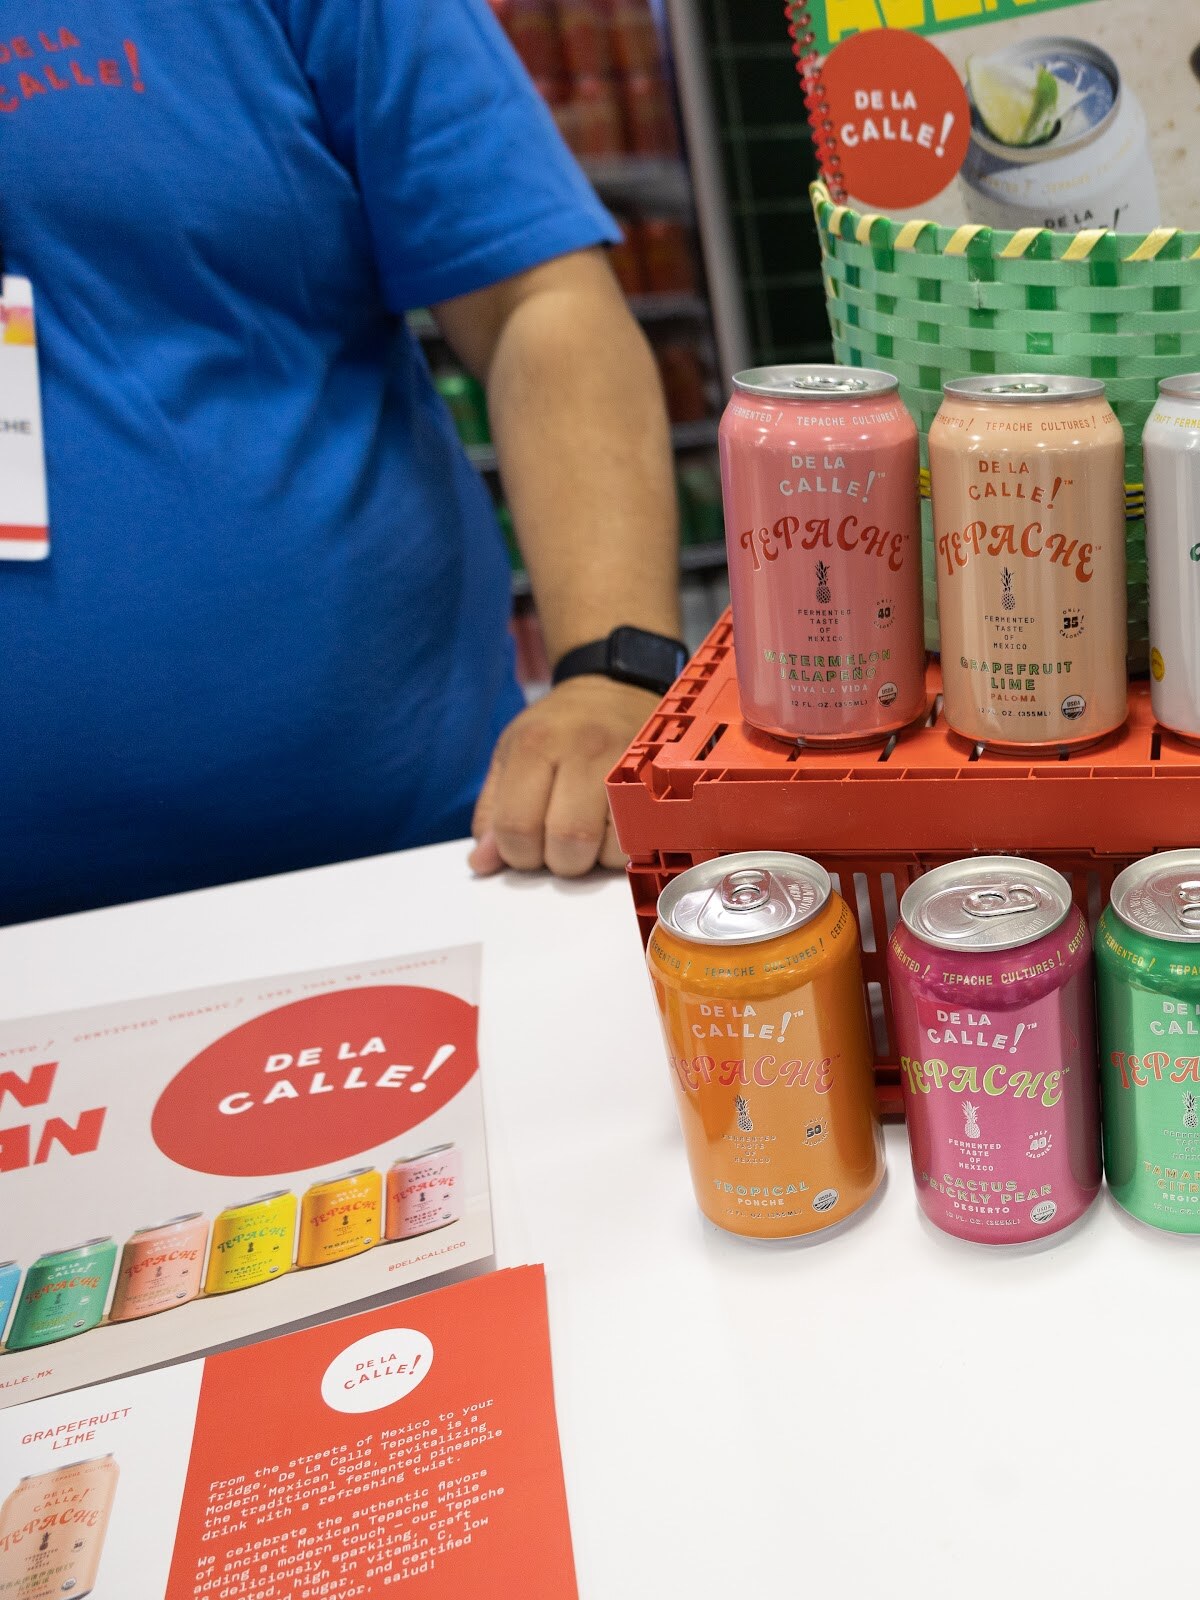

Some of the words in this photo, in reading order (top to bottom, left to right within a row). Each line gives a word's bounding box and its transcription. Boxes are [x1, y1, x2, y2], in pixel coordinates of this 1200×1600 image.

[37, 26, 81, 53] LA
[854, 90, 884, 111] DE
[890, 91, 917, 111] LA
[840, 112, 956, 157] CALLE!
[797, 415, 845, 427] TEPACHE
[851, 407, 901, 425] CULTURES!
[986, 421, 1033, 432] TEPACHE
[1041, 416, 1097, 432] CULTURES!
[791, 455, 816, 470] DE
[823, 456, 846, 470] LA
[979, 460, 1000, 473] DE
[1008, 461, 1030, 474] LA
[779, 470, 876, 504] CALLE!
[968, 476, 1062, 509] CALLE!
[739, 515, 905, 573] TEPACHE
[938, 520, 1094, 583] TEPACHE
[797, 608, 852, 616] FERMENTED
[877, 606, 892, 619] 40
[984, 615, 1035, 624] FERMENTED
[993, 642, 1027, 650] MEXICO
[764, 649, 892, 668] WATERMELON
[960, 656, 1073, 676] GRAPEFRUIT
[779, 667, 877, 682] JALAPEÑO
[990, 677, 1036, 691] LIME
[841, 684, 869, 694] VIDA
[990, 694, 1036, 702] PALOMA
[704, 966, 756, 977] TEPACHE
[942, 972, 993, 986] TEPACHE
[1001, 950, 1064, 984] CULTURES!
[700, 1004, 725, 1017] DE
[732, 1004, 757, 1018] LA
[936, 1010, 961, 1025] DE
[967, 1013, 991, 1026] LA
[1162, 1001, 1188, 1015] DE
[691, 1011, 792, 1043] CALLE!
[926, 1022, 1025, 1054] CALLE!
[263, 1046, 321, 1074] DE
[337, 1036, 388, 1061] LA
[217, 1043, 457, 1116] CALLE!
[900, 1055, 1063, 1107] TEPACHE
[806, 1124, 822, 1138] 50
[948, 1138, 1002, 1150] FERMENTED
[960, 1148, 990, 1157] TASTE
[1025, 1144, 1053, 1159] CALORIES
[958, 1162, 994, 1172] MEXICO
[392, 1176, 456, 1203] TEPACHE
[713, 1179, 810, 1197] TROPICAL
[943, 1173, 1018, 1193] CACTUS
[737, 1198, 785, 1206] PONCHE
[1001, 1184, 1053, 1205] PEAR
[953, 1201, 1010, 1214] DESIERTO
[388, 1241, 467, 1272] @DELACALLECO
[343, 1354, 422, 1390] CALLE!
[355, 1359, 375, 1372] DE
[380, 1353, 397, 1364] LA
[20, 1406, 134, 1446] GRAPEFRUIT
[52, 1429, 97, 1451] LIME
[209, 1474, 246, 1492] From
[254, 1465, 280, 1478] the
[288, 1444, 348, 1468] streets
[381, 1419, 430, 1440] Mexico
[462, 1398, 494, 1416] your
[205, 1493, 260, 1516] Modern
[268, 1472, 330, 1497] Mexican
[338, 1458, 378, 1476] Soda,
[388, 1422, 488, 1461] revitalizing
[208, 1482, 268, 1503] fridge,
[330, 1447, 373, 1467] Calle
[380, 1427, 438, 1451] Tepache
[203, 1513, 231, 1529] the
[240, 1481, 337, 1518] traditional
[345, 1454, 422, 1485] fermented
[430, 1428, 503, 1460] pineapple
[202, 1520, 247, 1542] drink
[256, 1507, 292, 1525] with
[318, 1472, 405, 1506] refreshing
[197, 1555, 216, 1567] We
[226, 1526, 308, 1559] celebrate
[316, 1515, 343, 1530] the
[352, 1488, 429, 1519] authentic
[437, 1469, 488, 1491] flavors
[223, 1545, 288, 1572] ancient
[297, 1521, 360, 1548] Mexican
[368, 1500, 429, 1526] Tepache
[437, 1483, 480, 1504] while
[193, 1569, 251, 1594] adding
[277, 1543, 332, 1568] modern
[341, 1526, 386, 1547] touch
[445, 1487, 505, 1513] Tepache
[402, 1534, 472, 1566] certified
[219, 1559, 322, 1599] deliciously
[332, 1529, 418, 1563] sparkling,
[429, 1509, 472, 1531] craft
[293, 1569, 330, 1589] high
[366, 1538, 429, 1564] vitamin
[463, 1516, 489, 1532] low
[383, 1559, 436, 1585] salud!
